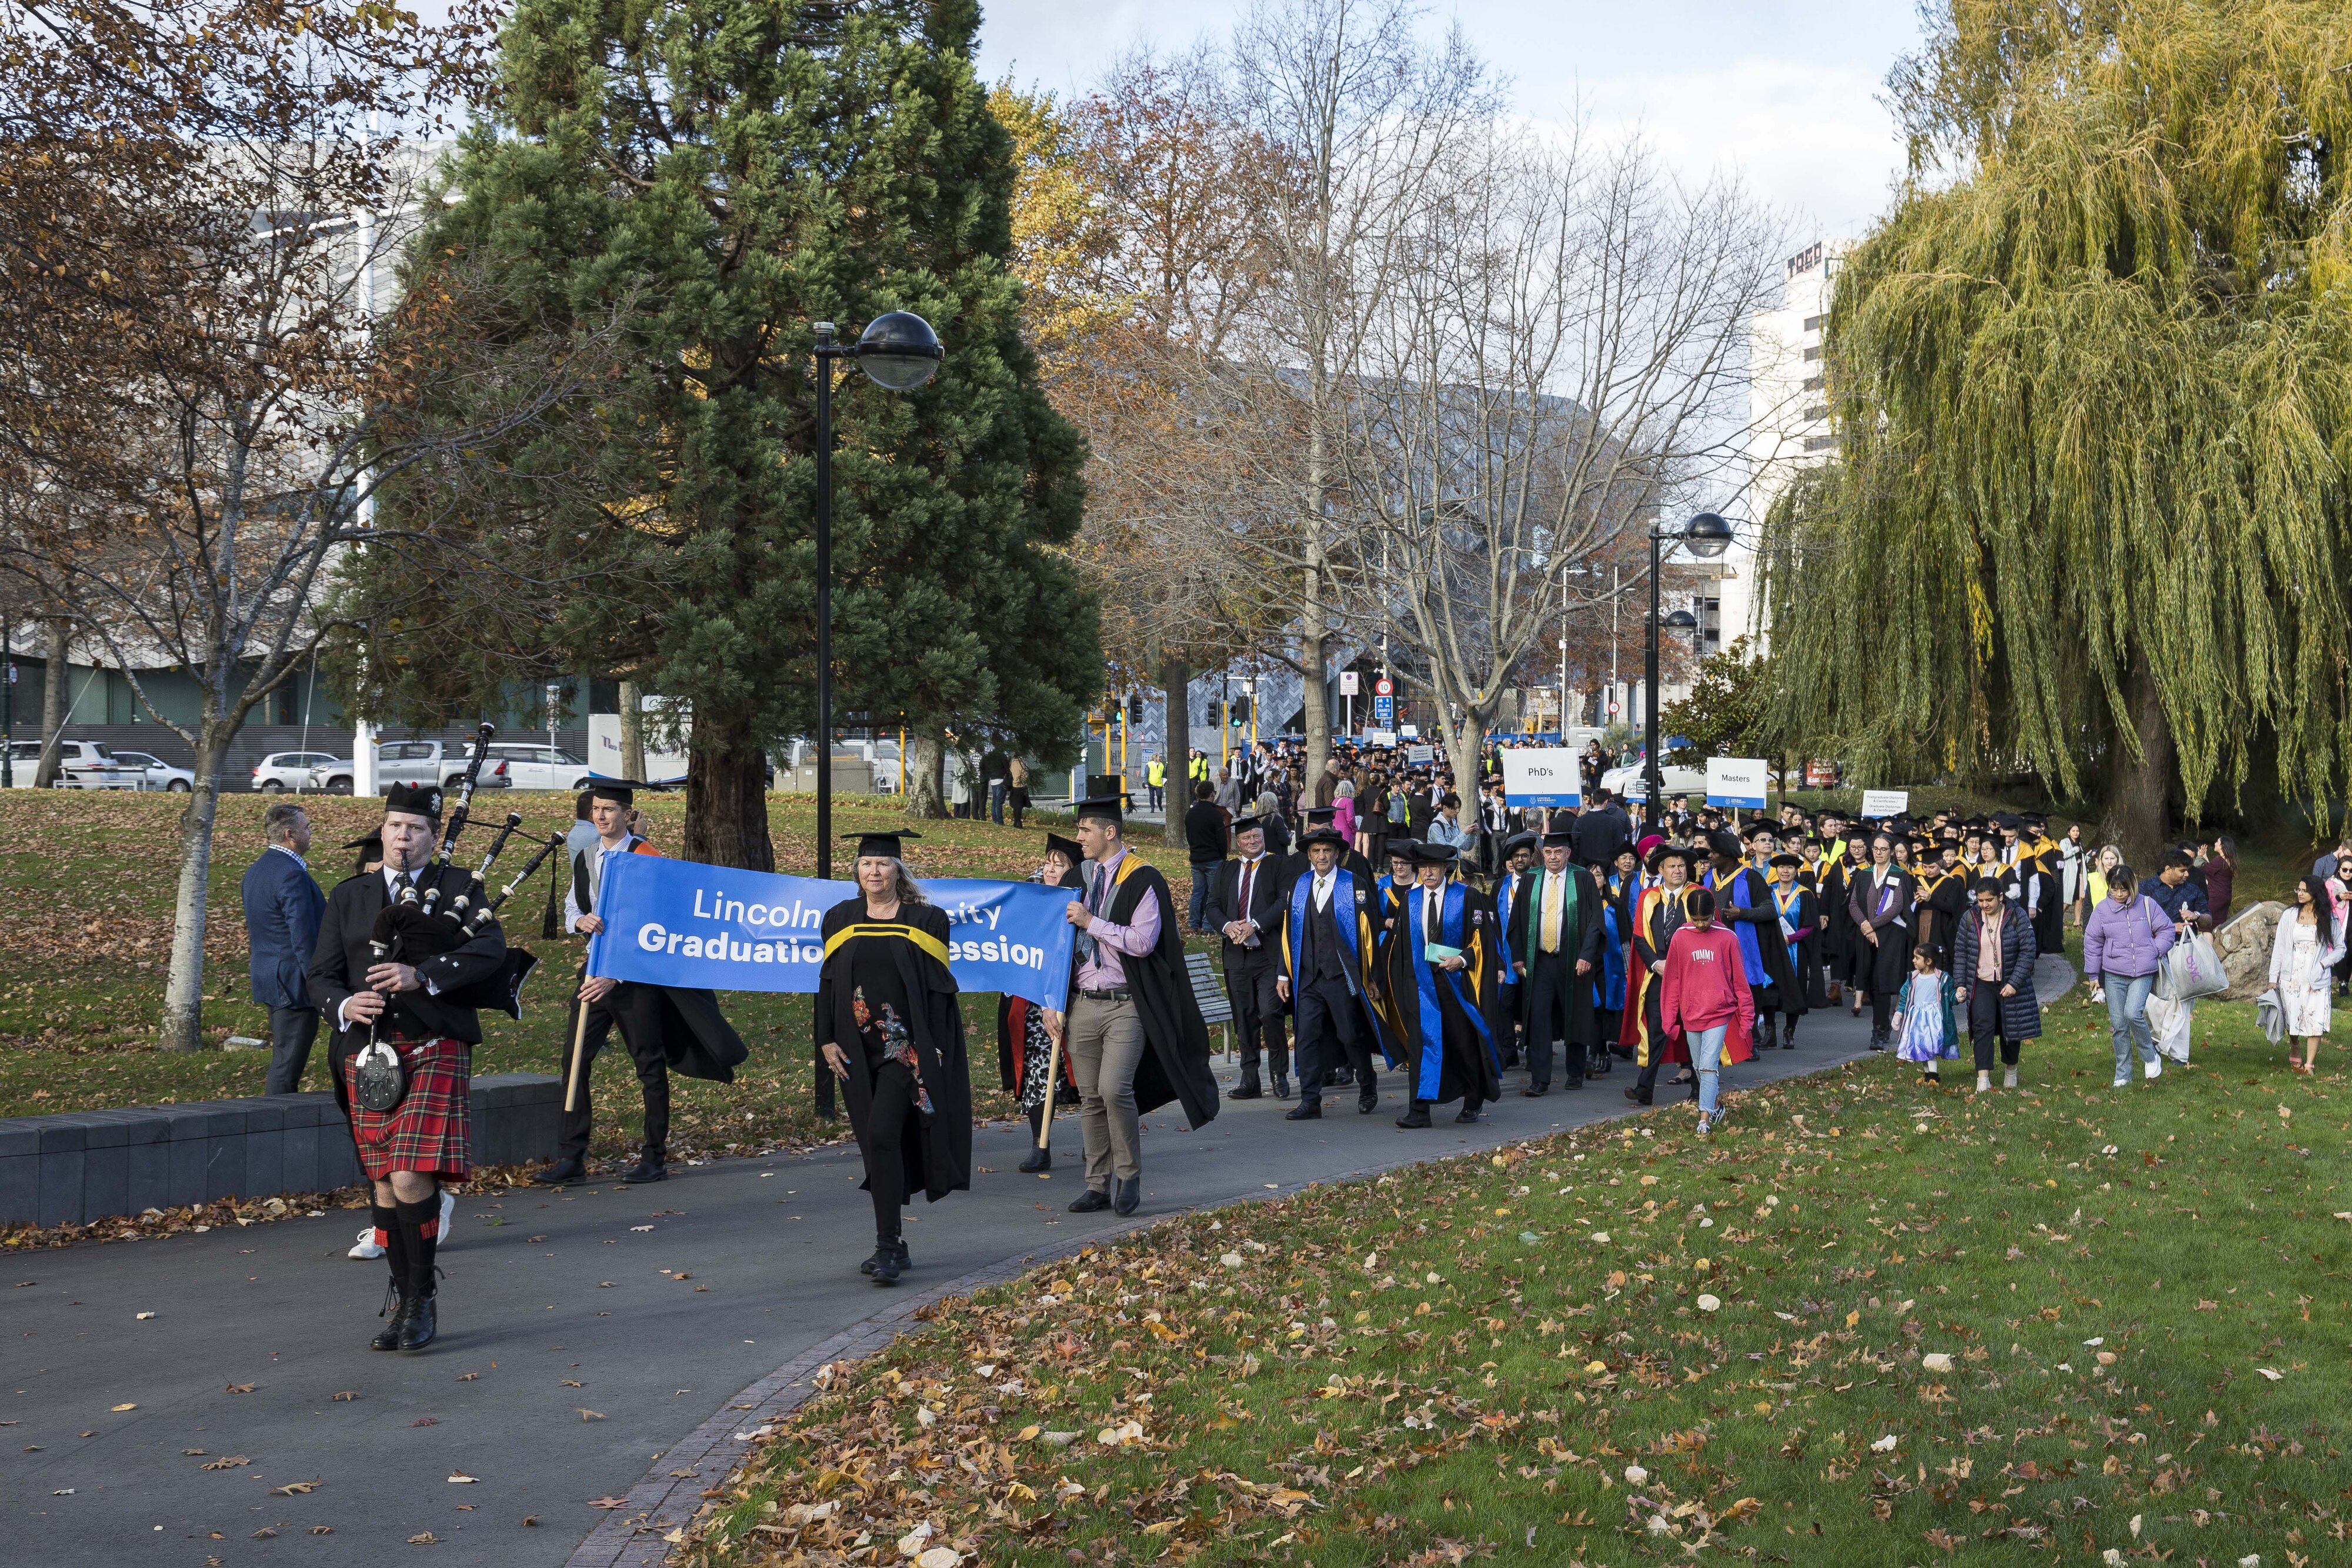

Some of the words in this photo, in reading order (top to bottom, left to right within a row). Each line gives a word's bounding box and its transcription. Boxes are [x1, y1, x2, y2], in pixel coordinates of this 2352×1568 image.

[1528, 768, 1553, 776] PhD's
[1722, 774, 1750, 782] Masters
[693, 889, 821, 929] Lincoln
[638, 923, 824, 963] Graduatio
[1692, 949, 1714, 962] TOMMY
